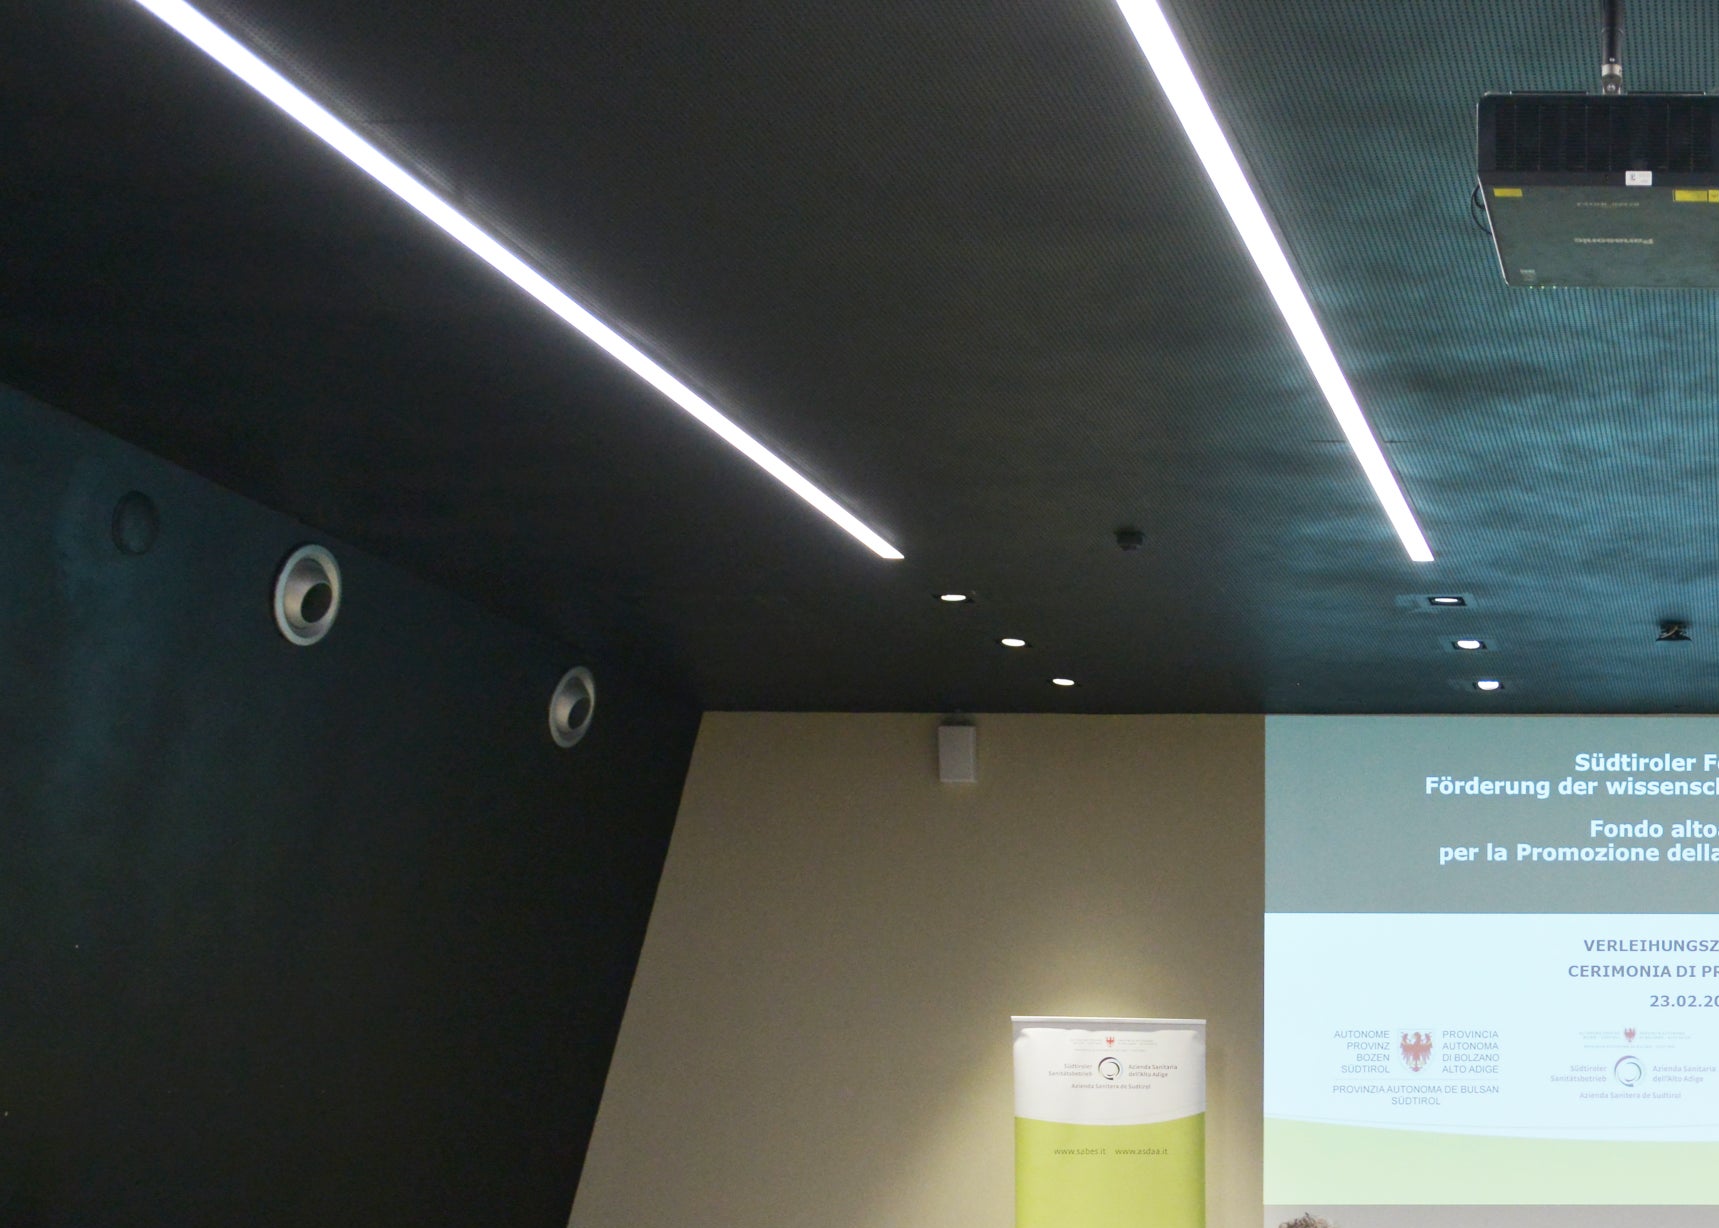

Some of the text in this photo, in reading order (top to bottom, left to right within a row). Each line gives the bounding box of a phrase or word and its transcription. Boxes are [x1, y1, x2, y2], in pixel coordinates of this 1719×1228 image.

[1574, 752, 1697, 772] Südtiroler
[1425, 775, 1550, 800] Förderung
[1557, 776, 1599, 796] der
[1590, 819, 1664, 839] Fondo
[1439, 846, 1480, 866] per
[1486, 842, 1508, 862] la
[1516, 842, 1660, 862] Promozione
[1567, 964, 1672, 978] CERIMONIA
[1676, 965, 1697, 978] DI
[1333, 1030, 1390, 1039] AUTONOME
[1442, 1030, 1499, 1039] PROVINCIA
[1346, 1041, 1390, 1050] PROVINZ
[1441, 1041, 1500, 1050] AUTONOMA
[1356, 1053, 1390, 1062] BOZEN
[1442, 1053, 1500, 1062] DI BOLZANO
[1341, 1062, 1390, 1073] SÜDTIROL
[1441, 1064, 1500, 1073] ALTO ADIGE
[1652, 1064, 1681, 1074] Azienda
[1332, 1085, 1500, 1094] PROVINZIA AUTONOMA DE BULSAN
[1579, 1091, 1609, 1100] Azienda
[1642, 1091, 1651, 1100] de
[1391, 1095, 1441, 1106] SÜDTIROL
[1053, 1147, 1169, 1156] www.sabes.it www.asdaa.it
